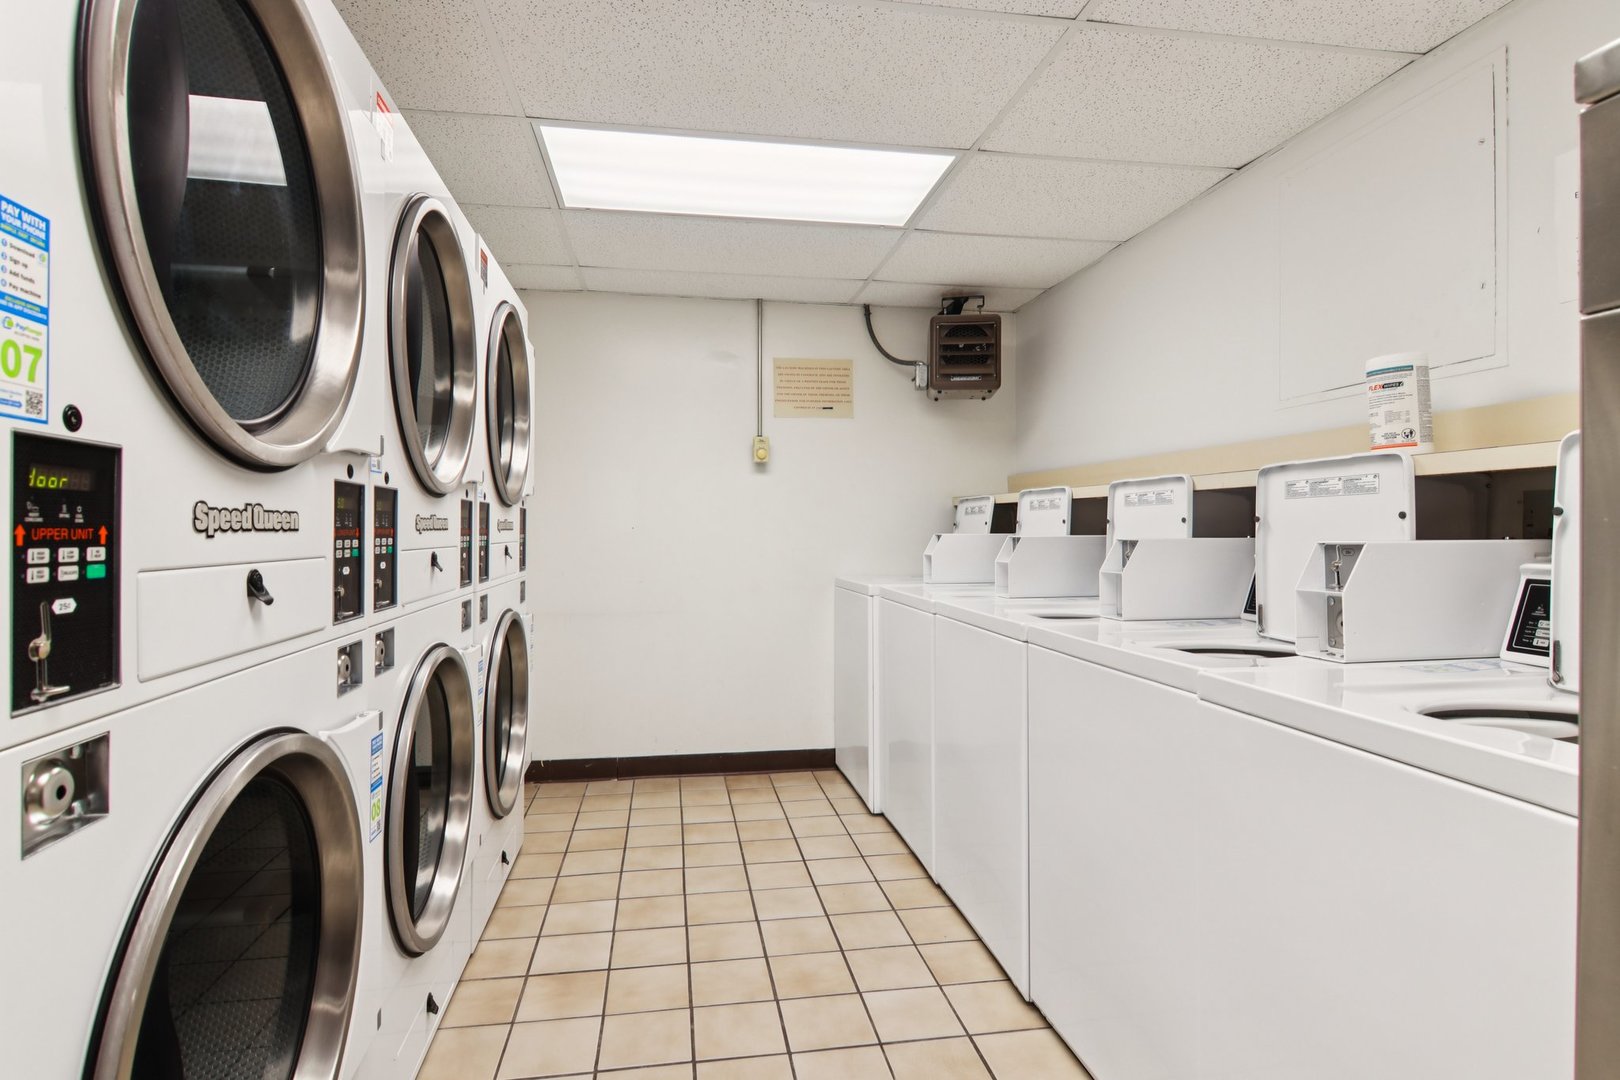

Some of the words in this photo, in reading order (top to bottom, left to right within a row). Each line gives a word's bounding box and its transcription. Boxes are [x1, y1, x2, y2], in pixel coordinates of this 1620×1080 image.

[1, 200, 20, 218] PAY
[21, 210, 46, 231] WITH
[1, 212, 22, 227] YOUR
[22, 222, 46, 240] PHONE
[0, 339, 42, 383] 07
[31, 527, 69, 541] UPPER
[70, 527, 94, 540] UNIT
